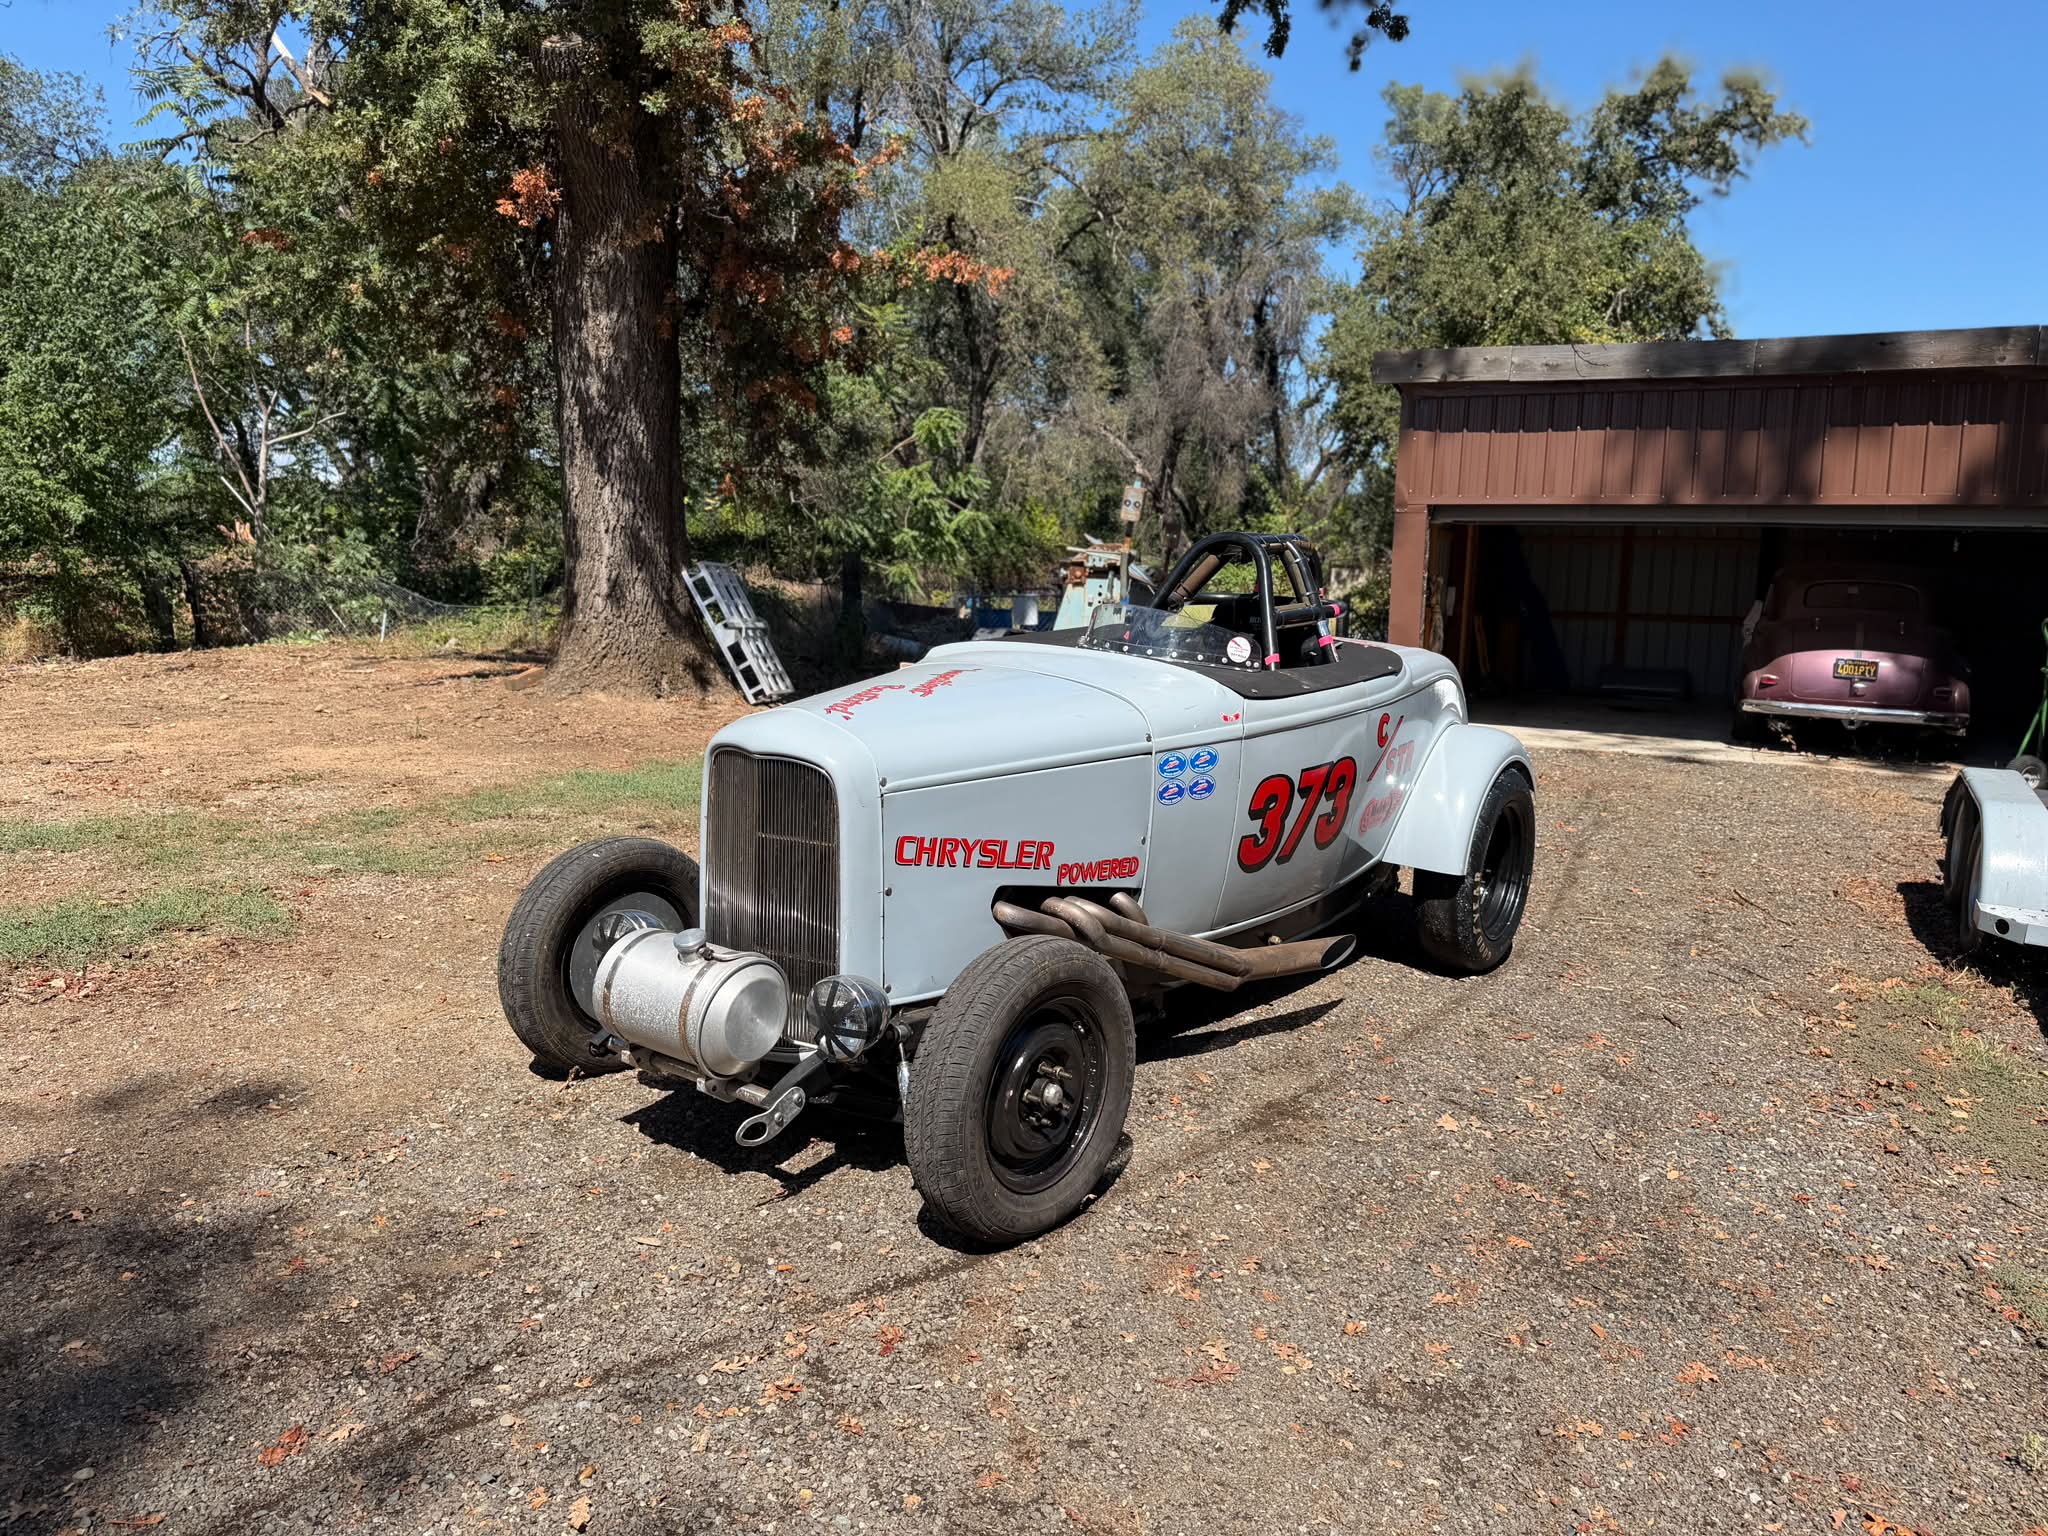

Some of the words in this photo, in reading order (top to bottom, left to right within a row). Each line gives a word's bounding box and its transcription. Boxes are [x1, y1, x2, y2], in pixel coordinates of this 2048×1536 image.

[1237, 756, 1358, 874] 373
[895, 835, 1055, 870] CHRYSLER
[1057, 856, 1140, 886] POWERED
